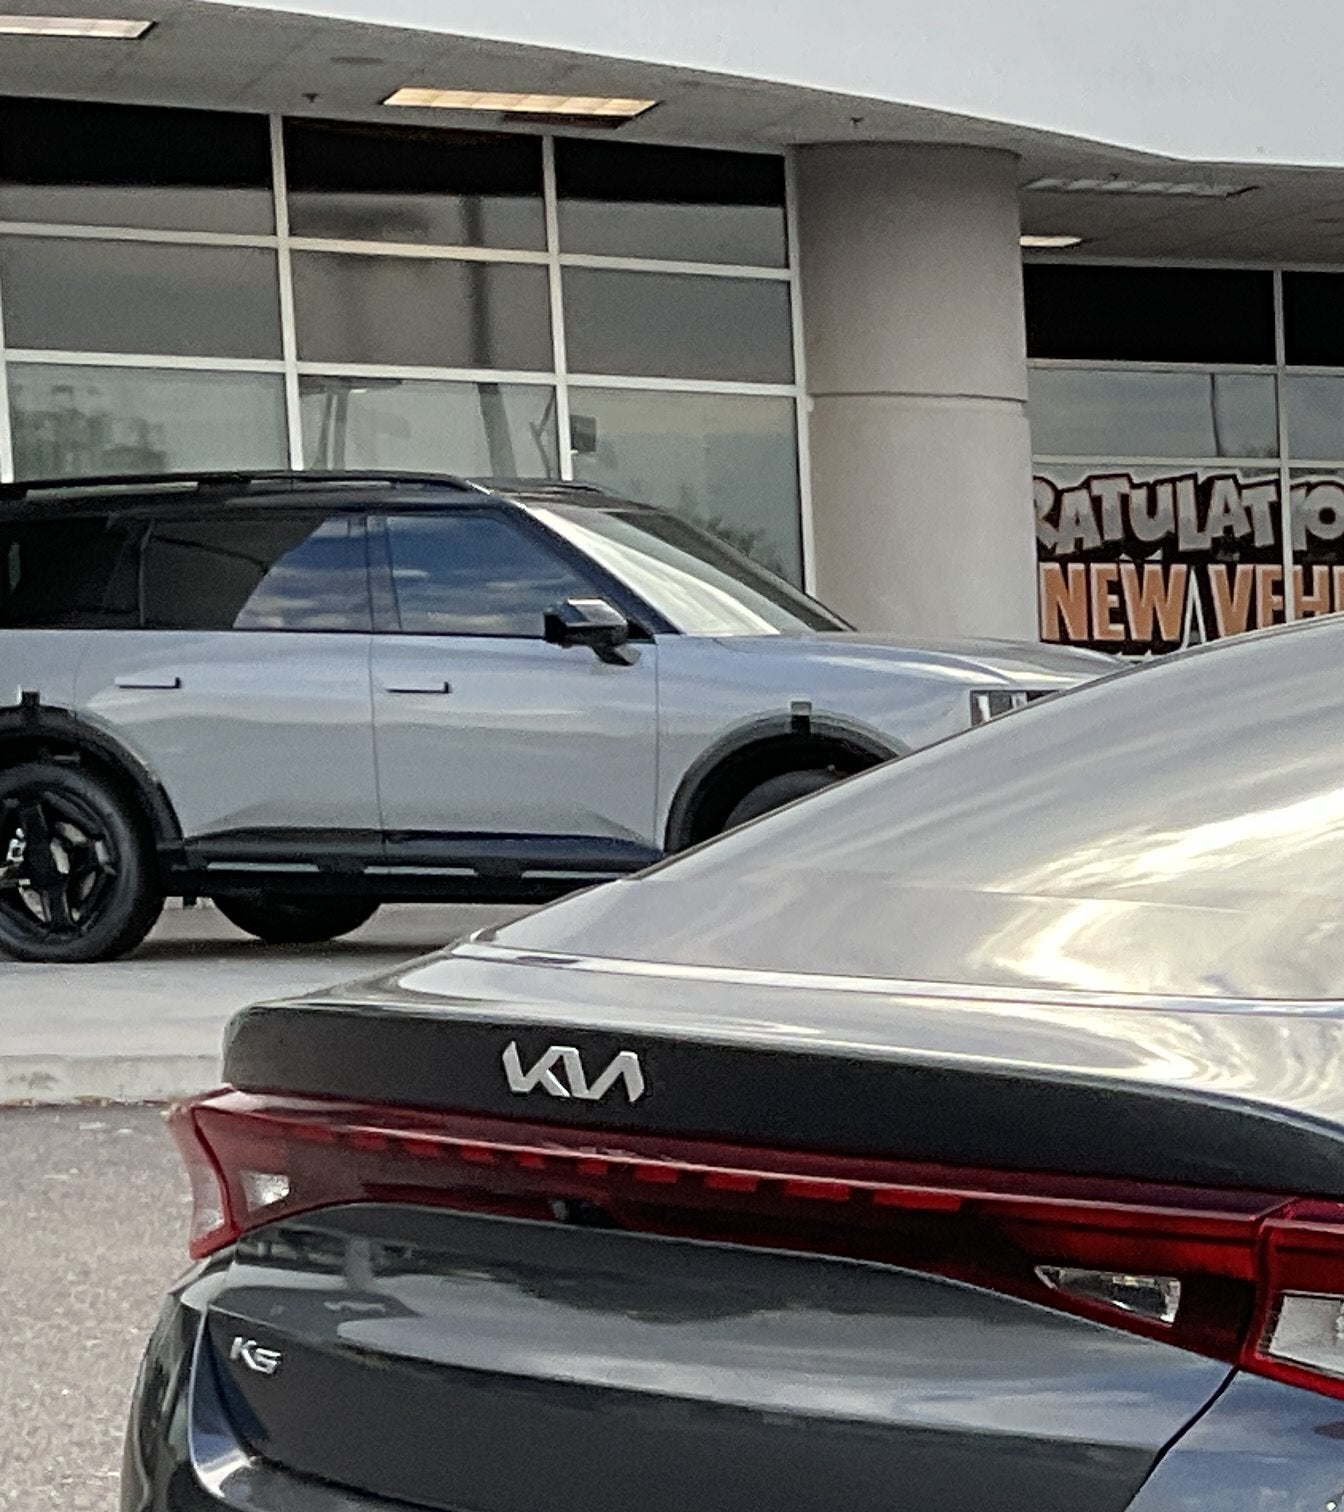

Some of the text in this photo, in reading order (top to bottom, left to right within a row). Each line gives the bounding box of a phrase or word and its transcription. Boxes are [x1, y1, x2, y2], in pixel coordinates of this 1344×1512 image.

[1040, 562, 1186, 641] NEW
[502, 1040, 645, 1102] KIA
[229, 1336, 283, 1375] K5
